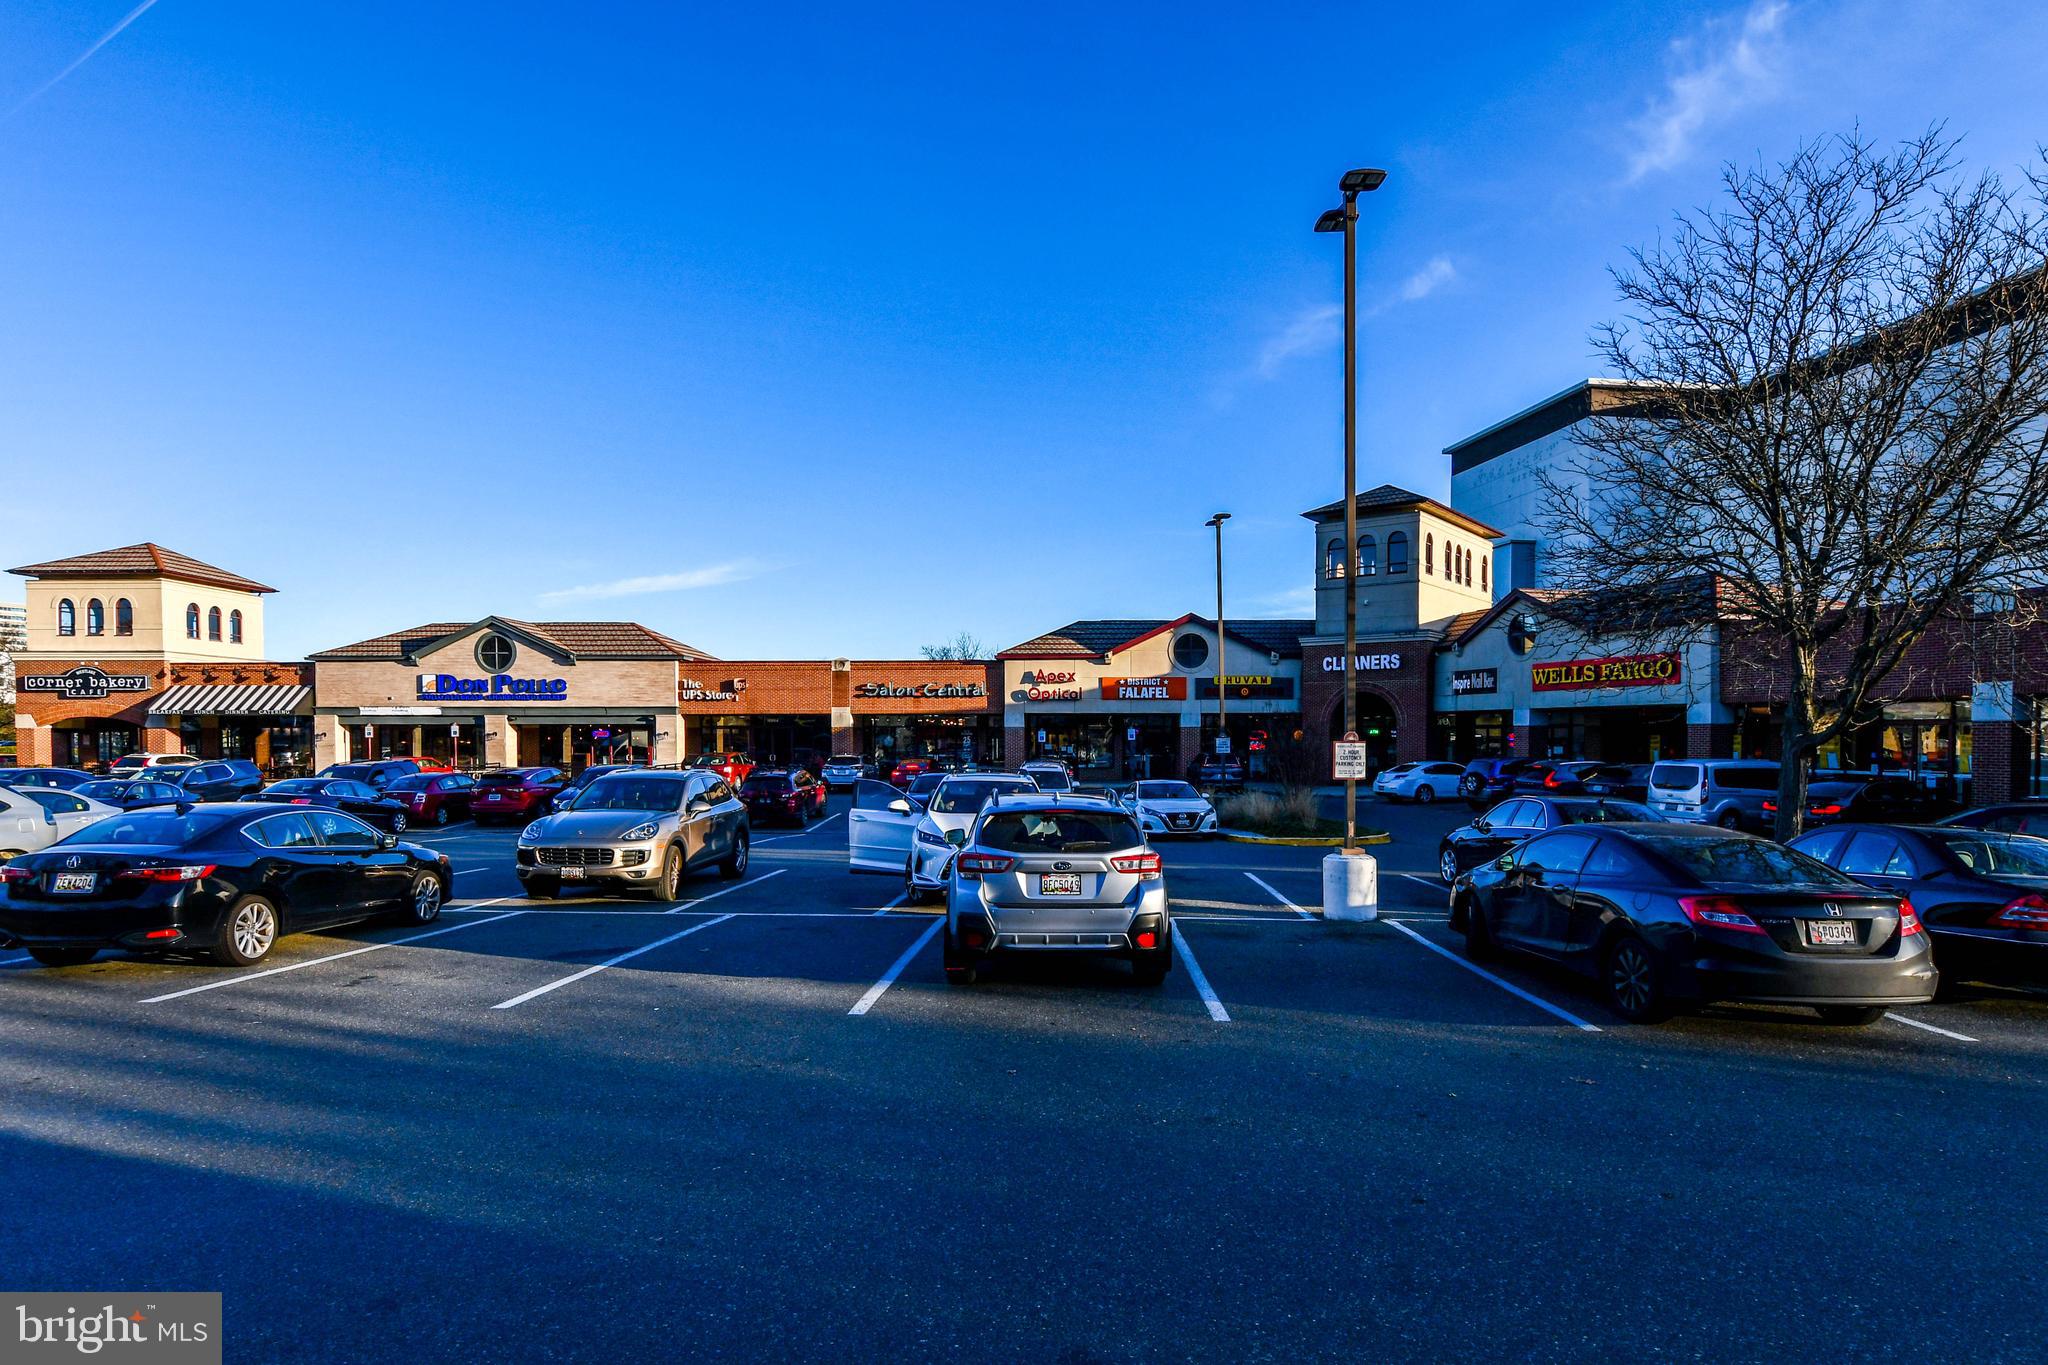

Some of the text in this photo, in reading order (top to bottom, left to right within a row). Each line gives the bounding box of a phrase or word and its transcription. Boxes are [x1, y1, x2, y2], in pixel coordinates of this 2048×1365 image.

[1035, 668, 1076, 684] Apex
[1532, 658, 1673, 685] WELLS FARGO
[28, 676, 144, 689] corner bakery
[682, 678, 703, 689] The
[865, 681, 990, 697] Salon Central
[1127, 678, 1161, 686] DISTRICT
[1452, 674, 1470, 694] Inspire
[1471, 672, 1483, 689] Nail
[682, 690, 735, 700] UPS Store
[1028, 687, 1083, 702] Optical
[1119, 686, 1170, 699] FALAFEL
